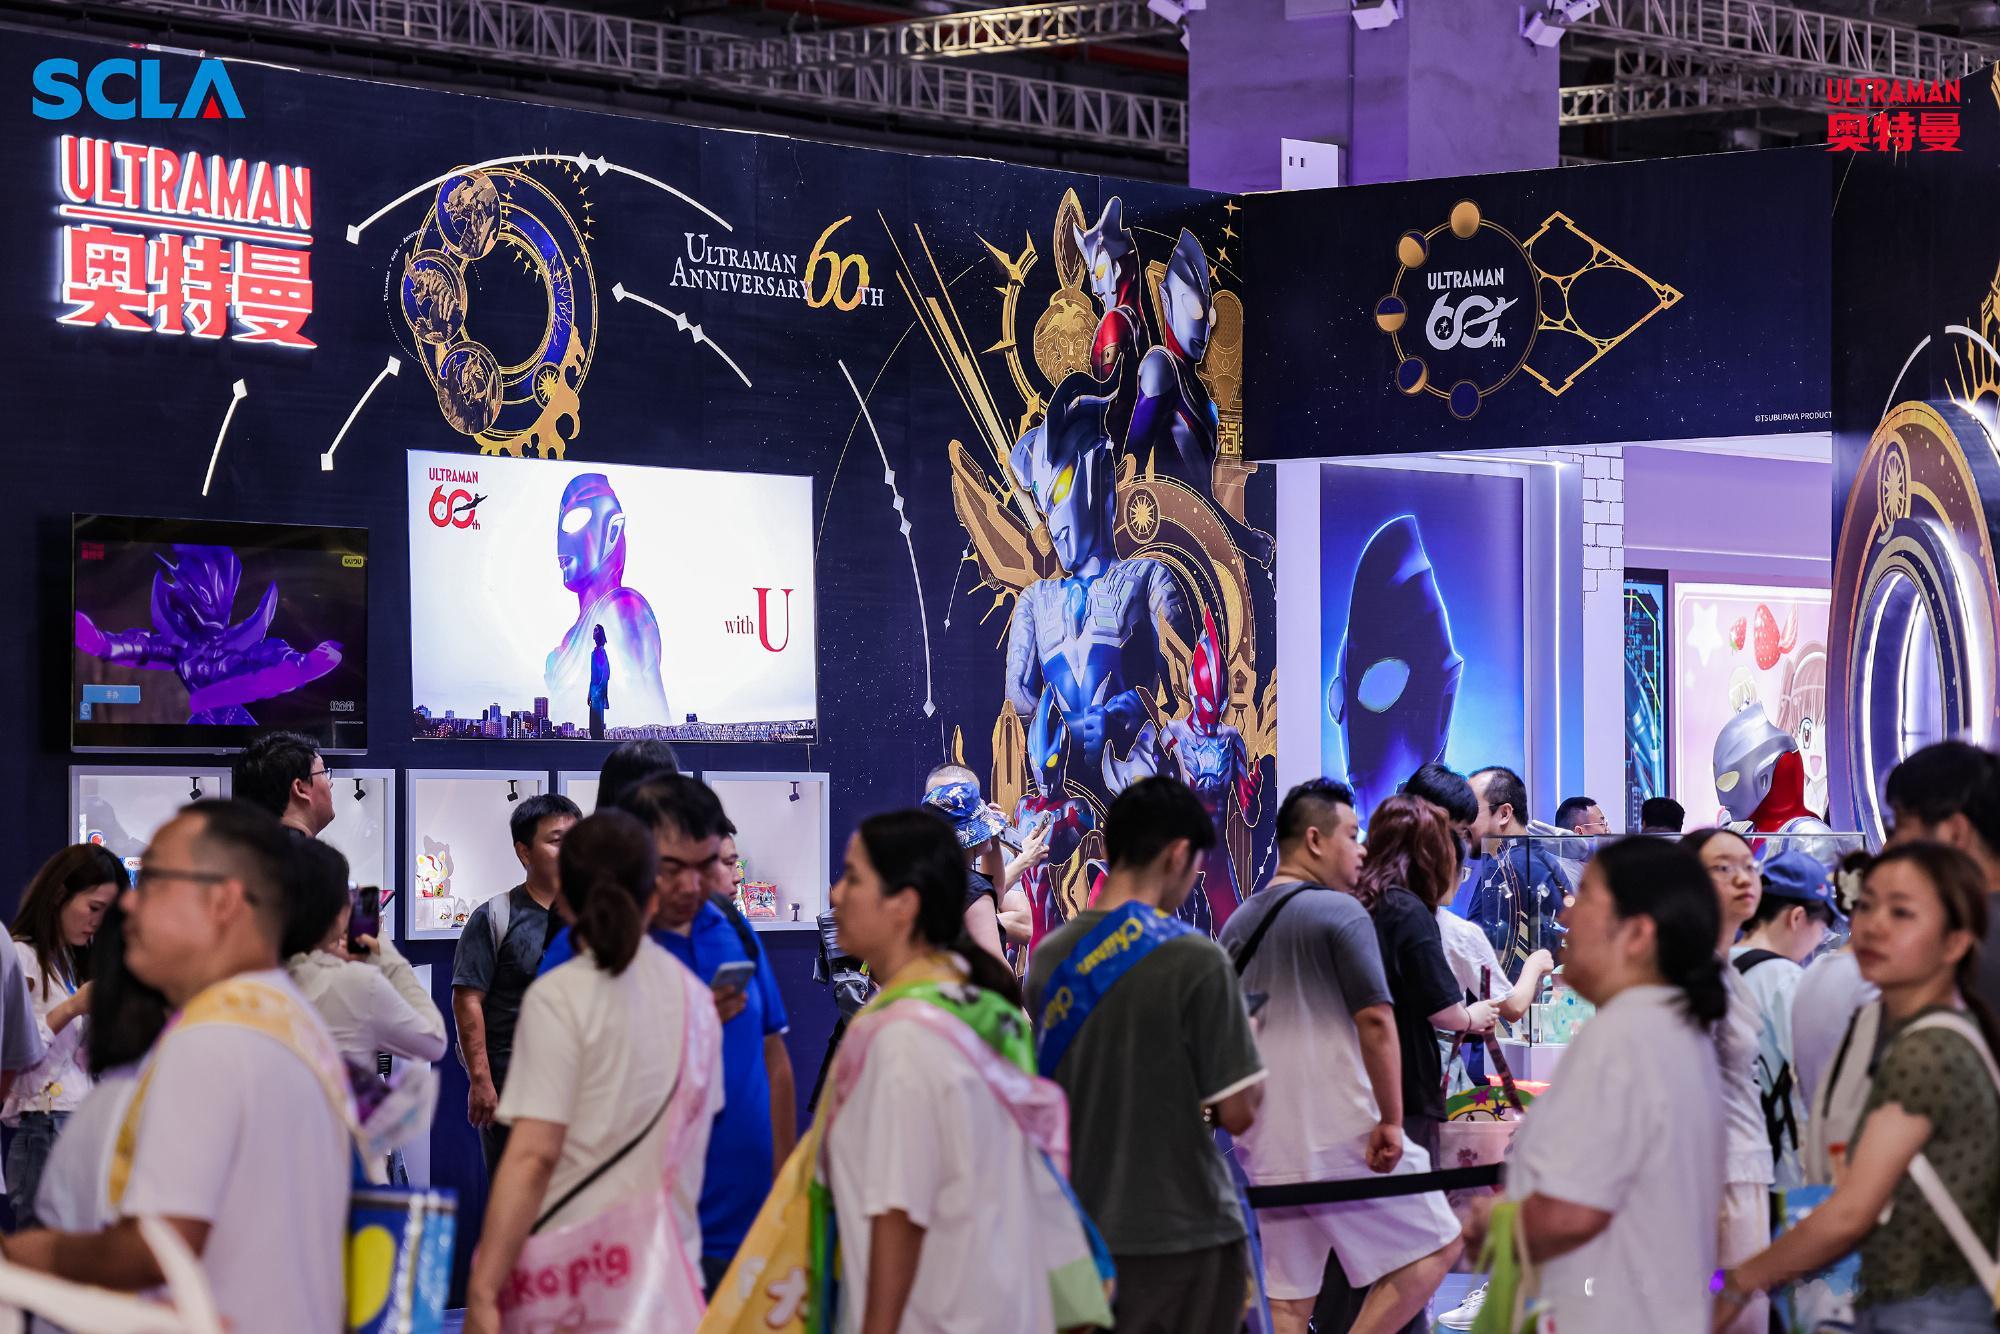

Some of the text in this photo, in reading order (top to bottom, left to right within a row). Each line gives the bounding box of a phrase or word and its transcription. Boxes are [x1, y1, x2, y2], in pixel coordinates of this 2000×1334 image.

[60, 134, 312, 230] ULTRAMAN
[56, 223, 318, 350] 奥特曼
[1427, 267, 1504, 290] ULTRAMAN
[428, 467, 479, 484] ULTRAMAN
[724, 587, 795, 653] with U
